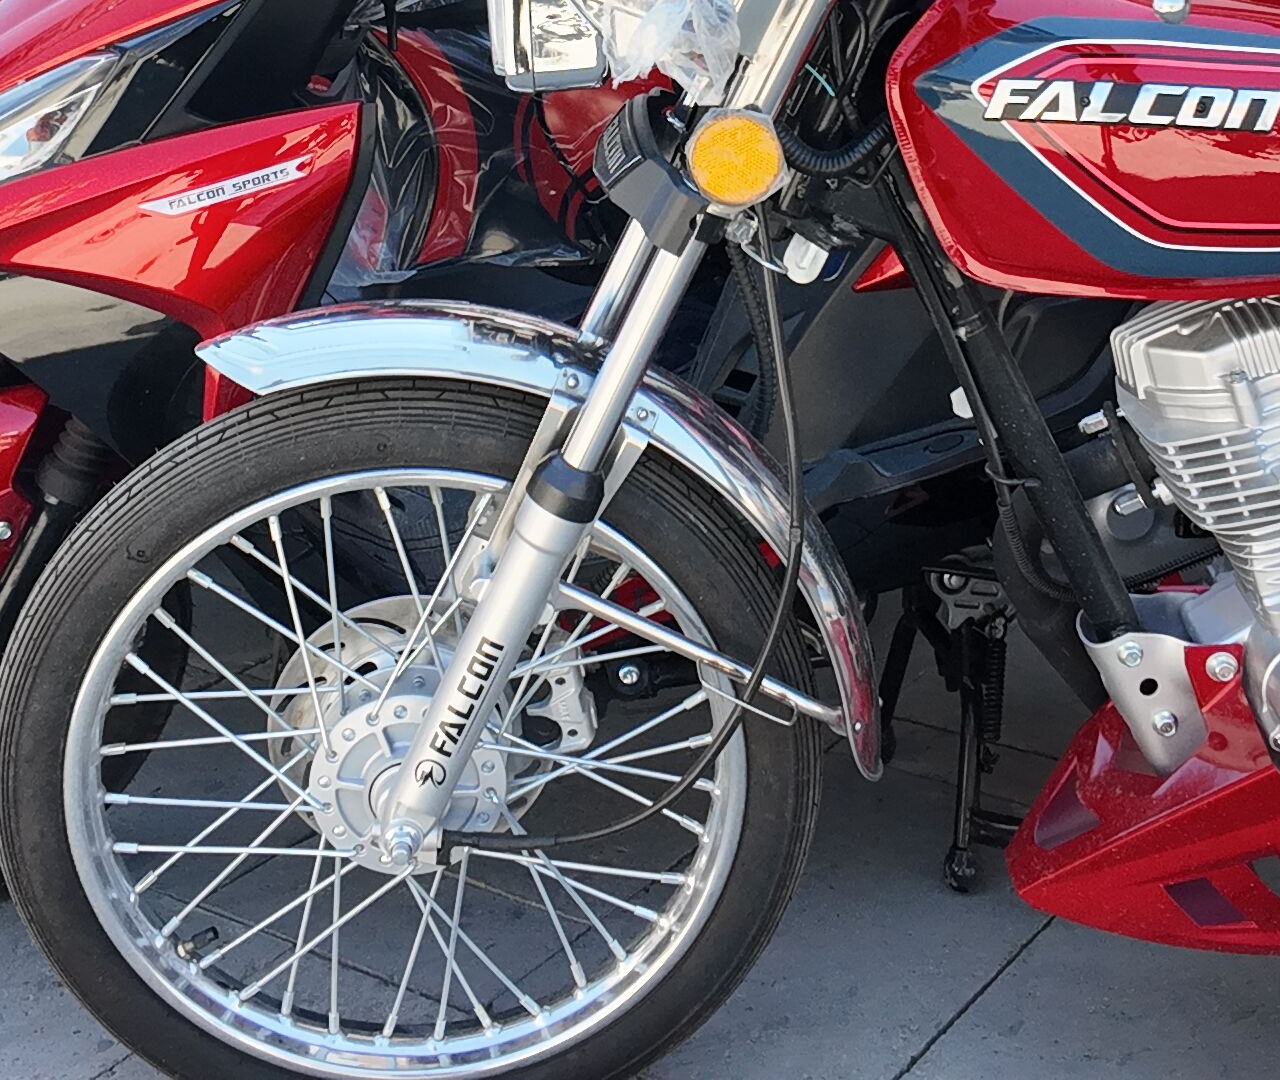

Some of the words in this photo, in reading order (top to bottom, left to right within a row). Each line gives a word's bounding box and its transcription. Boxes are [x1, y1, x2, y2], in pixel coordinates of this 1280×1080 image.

[168, 187, 226, 211] FALCON
[232, 168, 290, 192] SPORTS
[428, 635, 505, 759] FALCON
